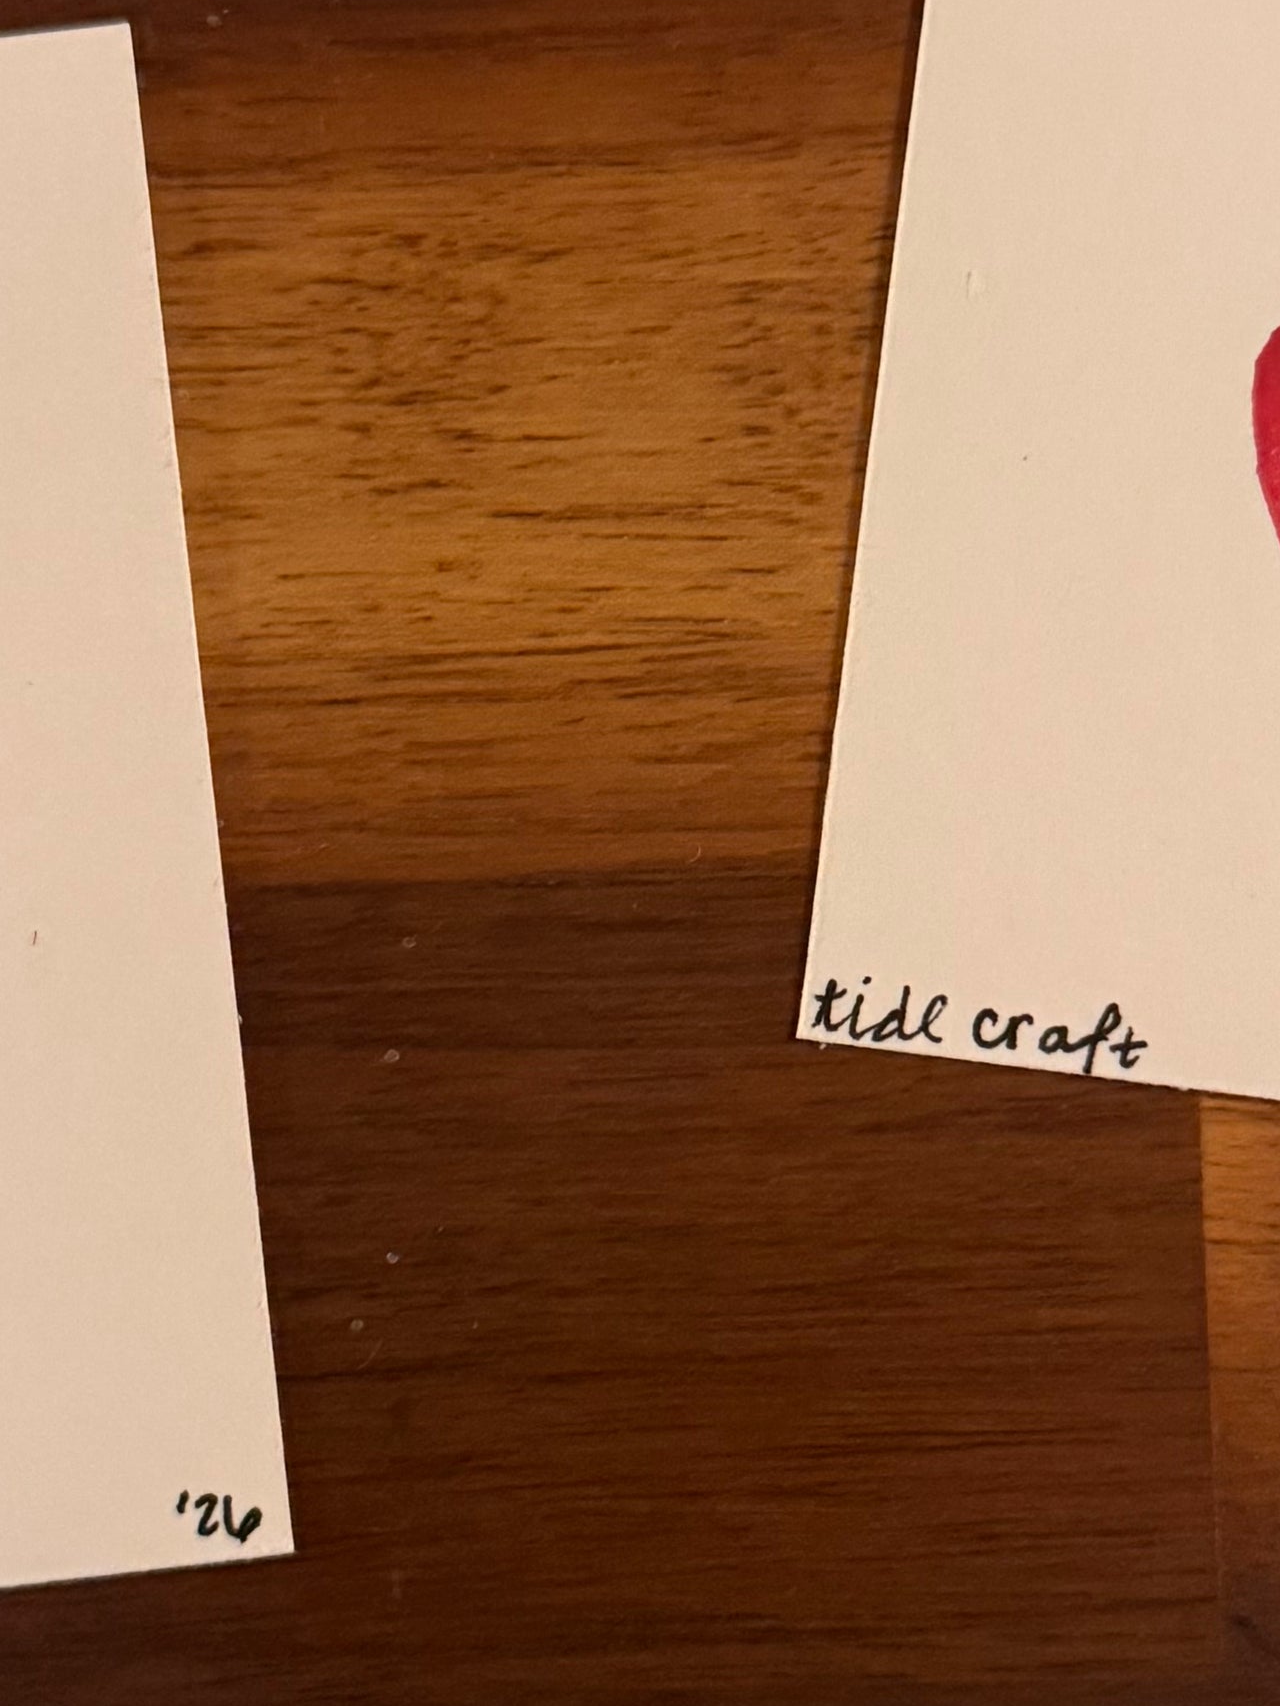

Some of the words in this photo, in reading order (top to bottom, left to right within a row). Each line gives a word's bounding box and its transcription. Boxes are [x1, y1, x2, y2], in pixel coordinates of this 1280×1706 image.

[811, 975, 949, 1044] tide
[971, 1002, 1149, 1075] craft
[176, 1488, 264, 1544] '26
